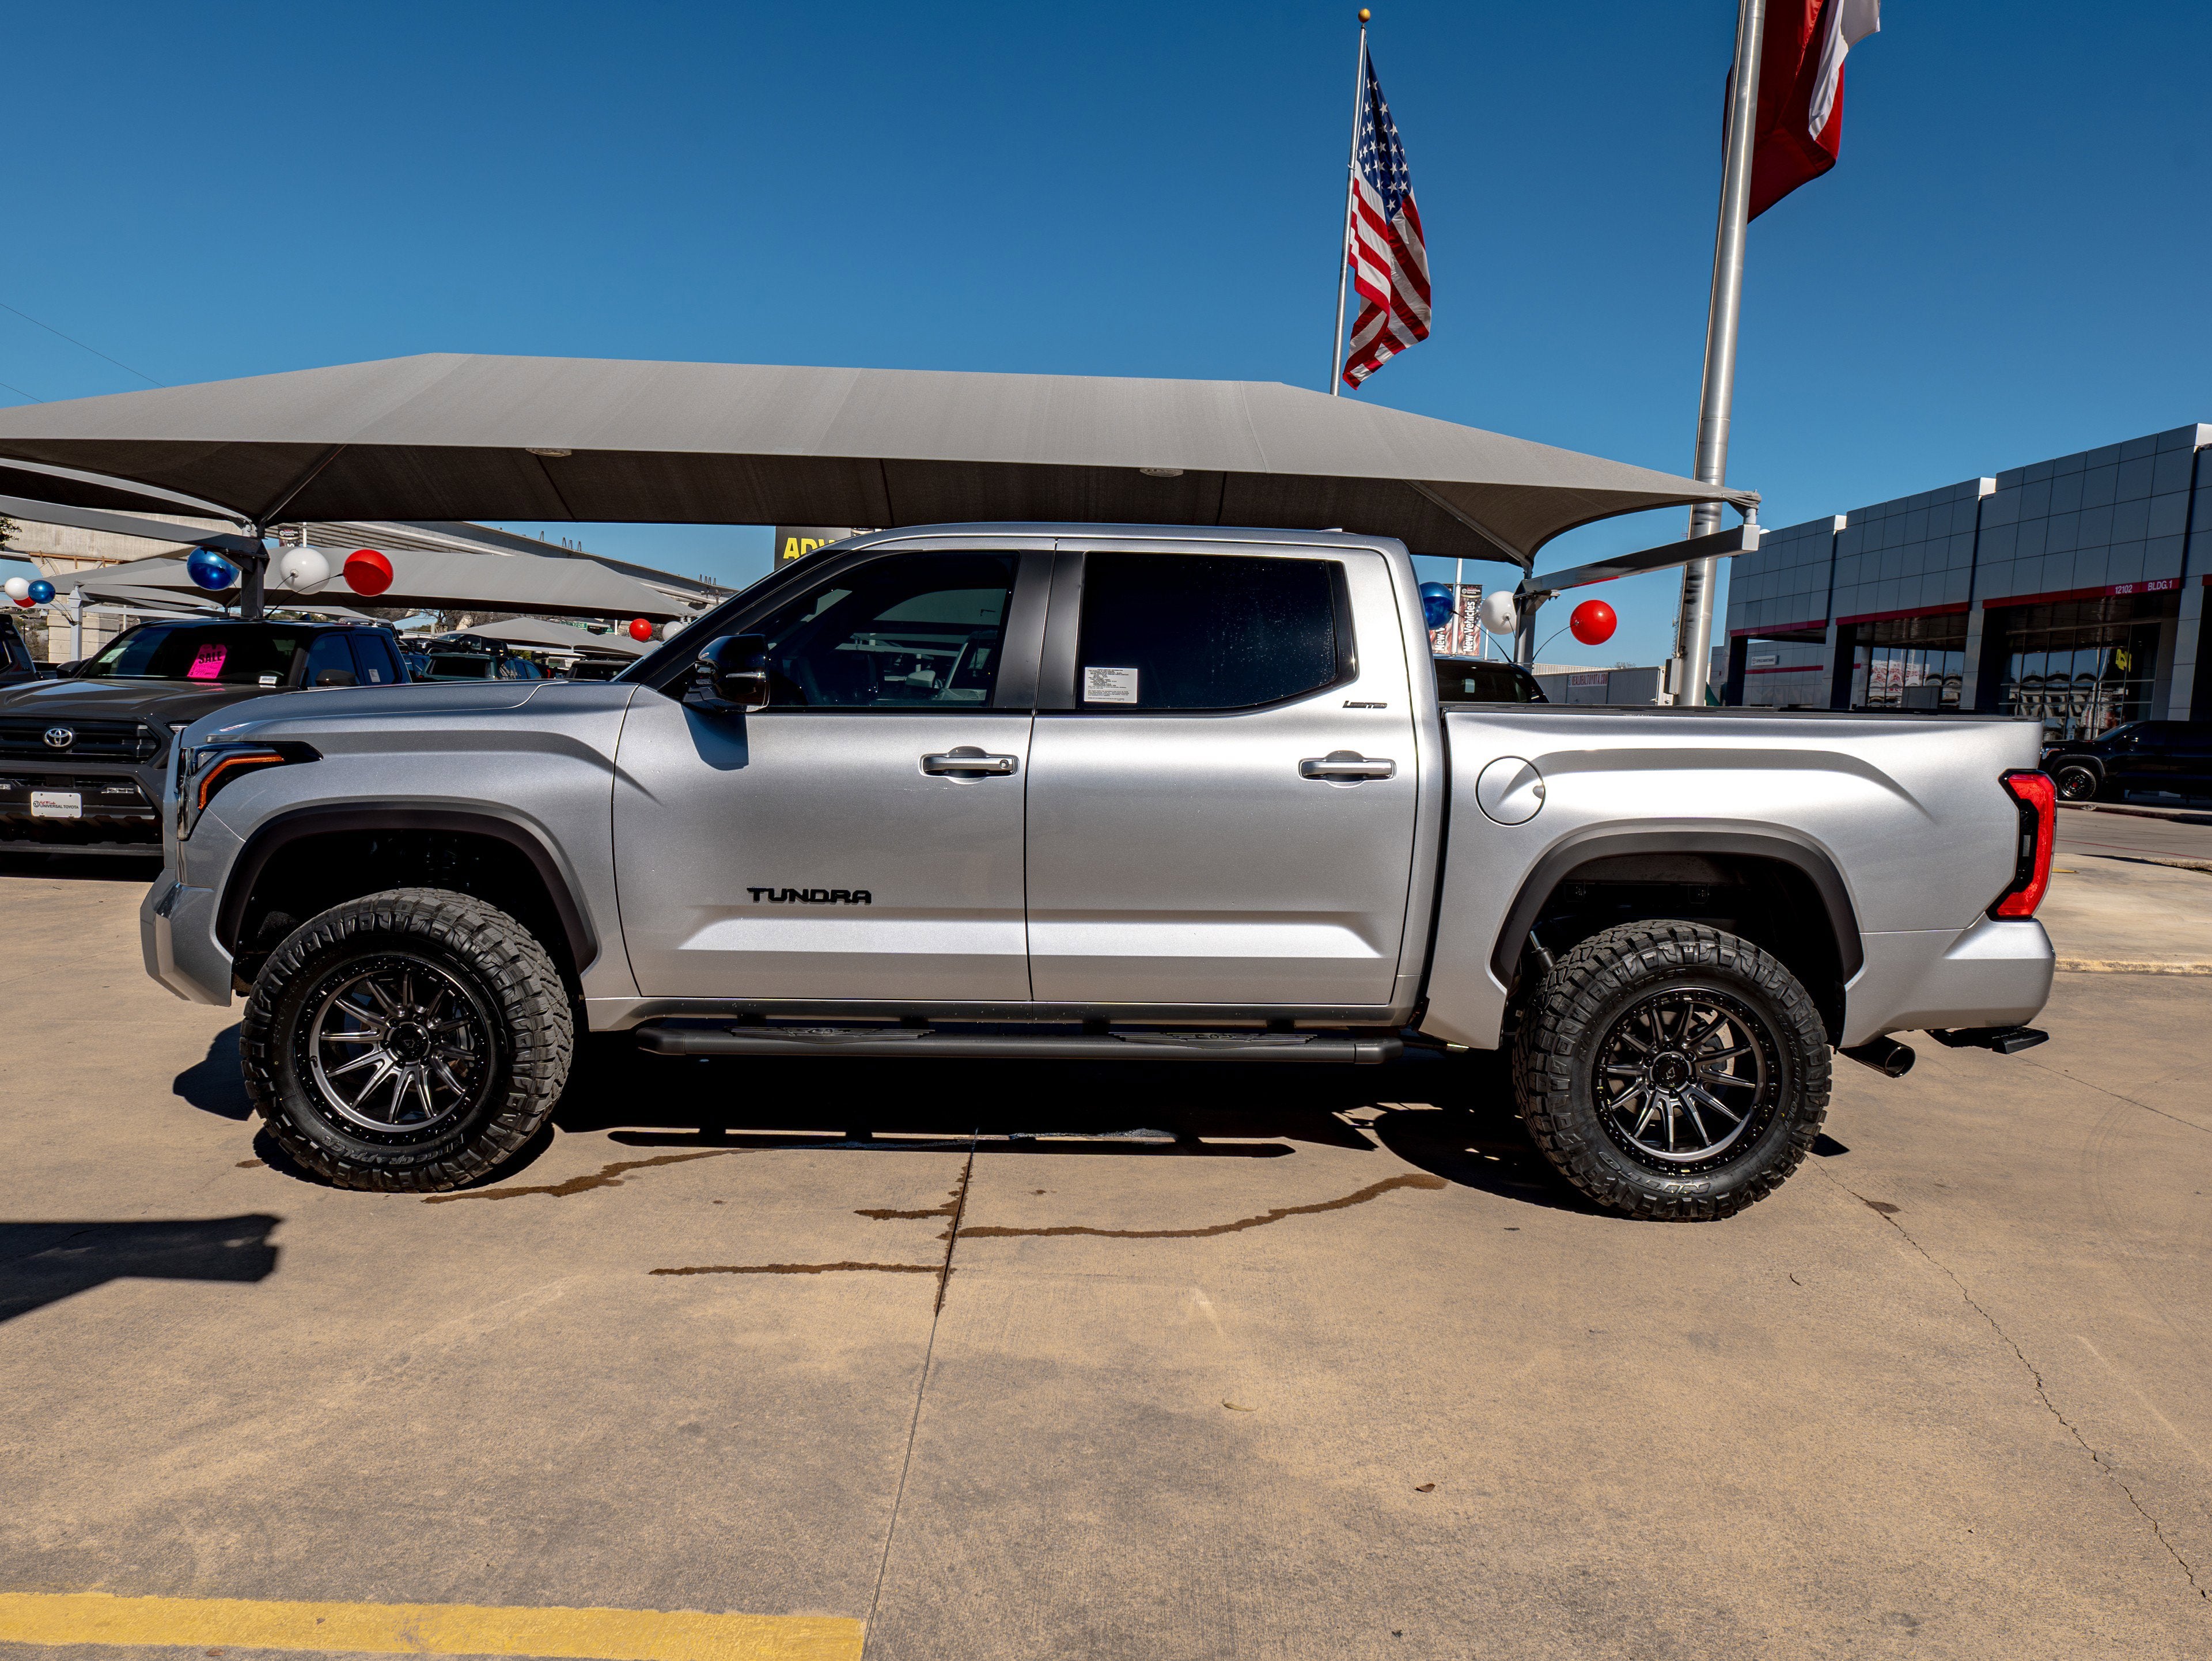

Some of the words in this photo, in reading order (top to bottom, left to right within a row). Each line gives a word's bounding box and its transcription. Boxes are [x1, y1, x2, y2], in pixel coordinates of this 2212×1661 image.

[2115, 584, 2133, 594] 12102
[1464, 601, 1475, 634] Vehicles
[1435, 633, 1445, 651] New
[1463, 634, 1474, 652] New
[198, 651, 223, 664] SALE
[1342, 700, 1388, 709] LIMITED
[747, 887, 872, 905] TUNDRA
[320, 1135, 415, 1166] GRAPPLER
[1599, 1151, 1712, 1195] NITTO
